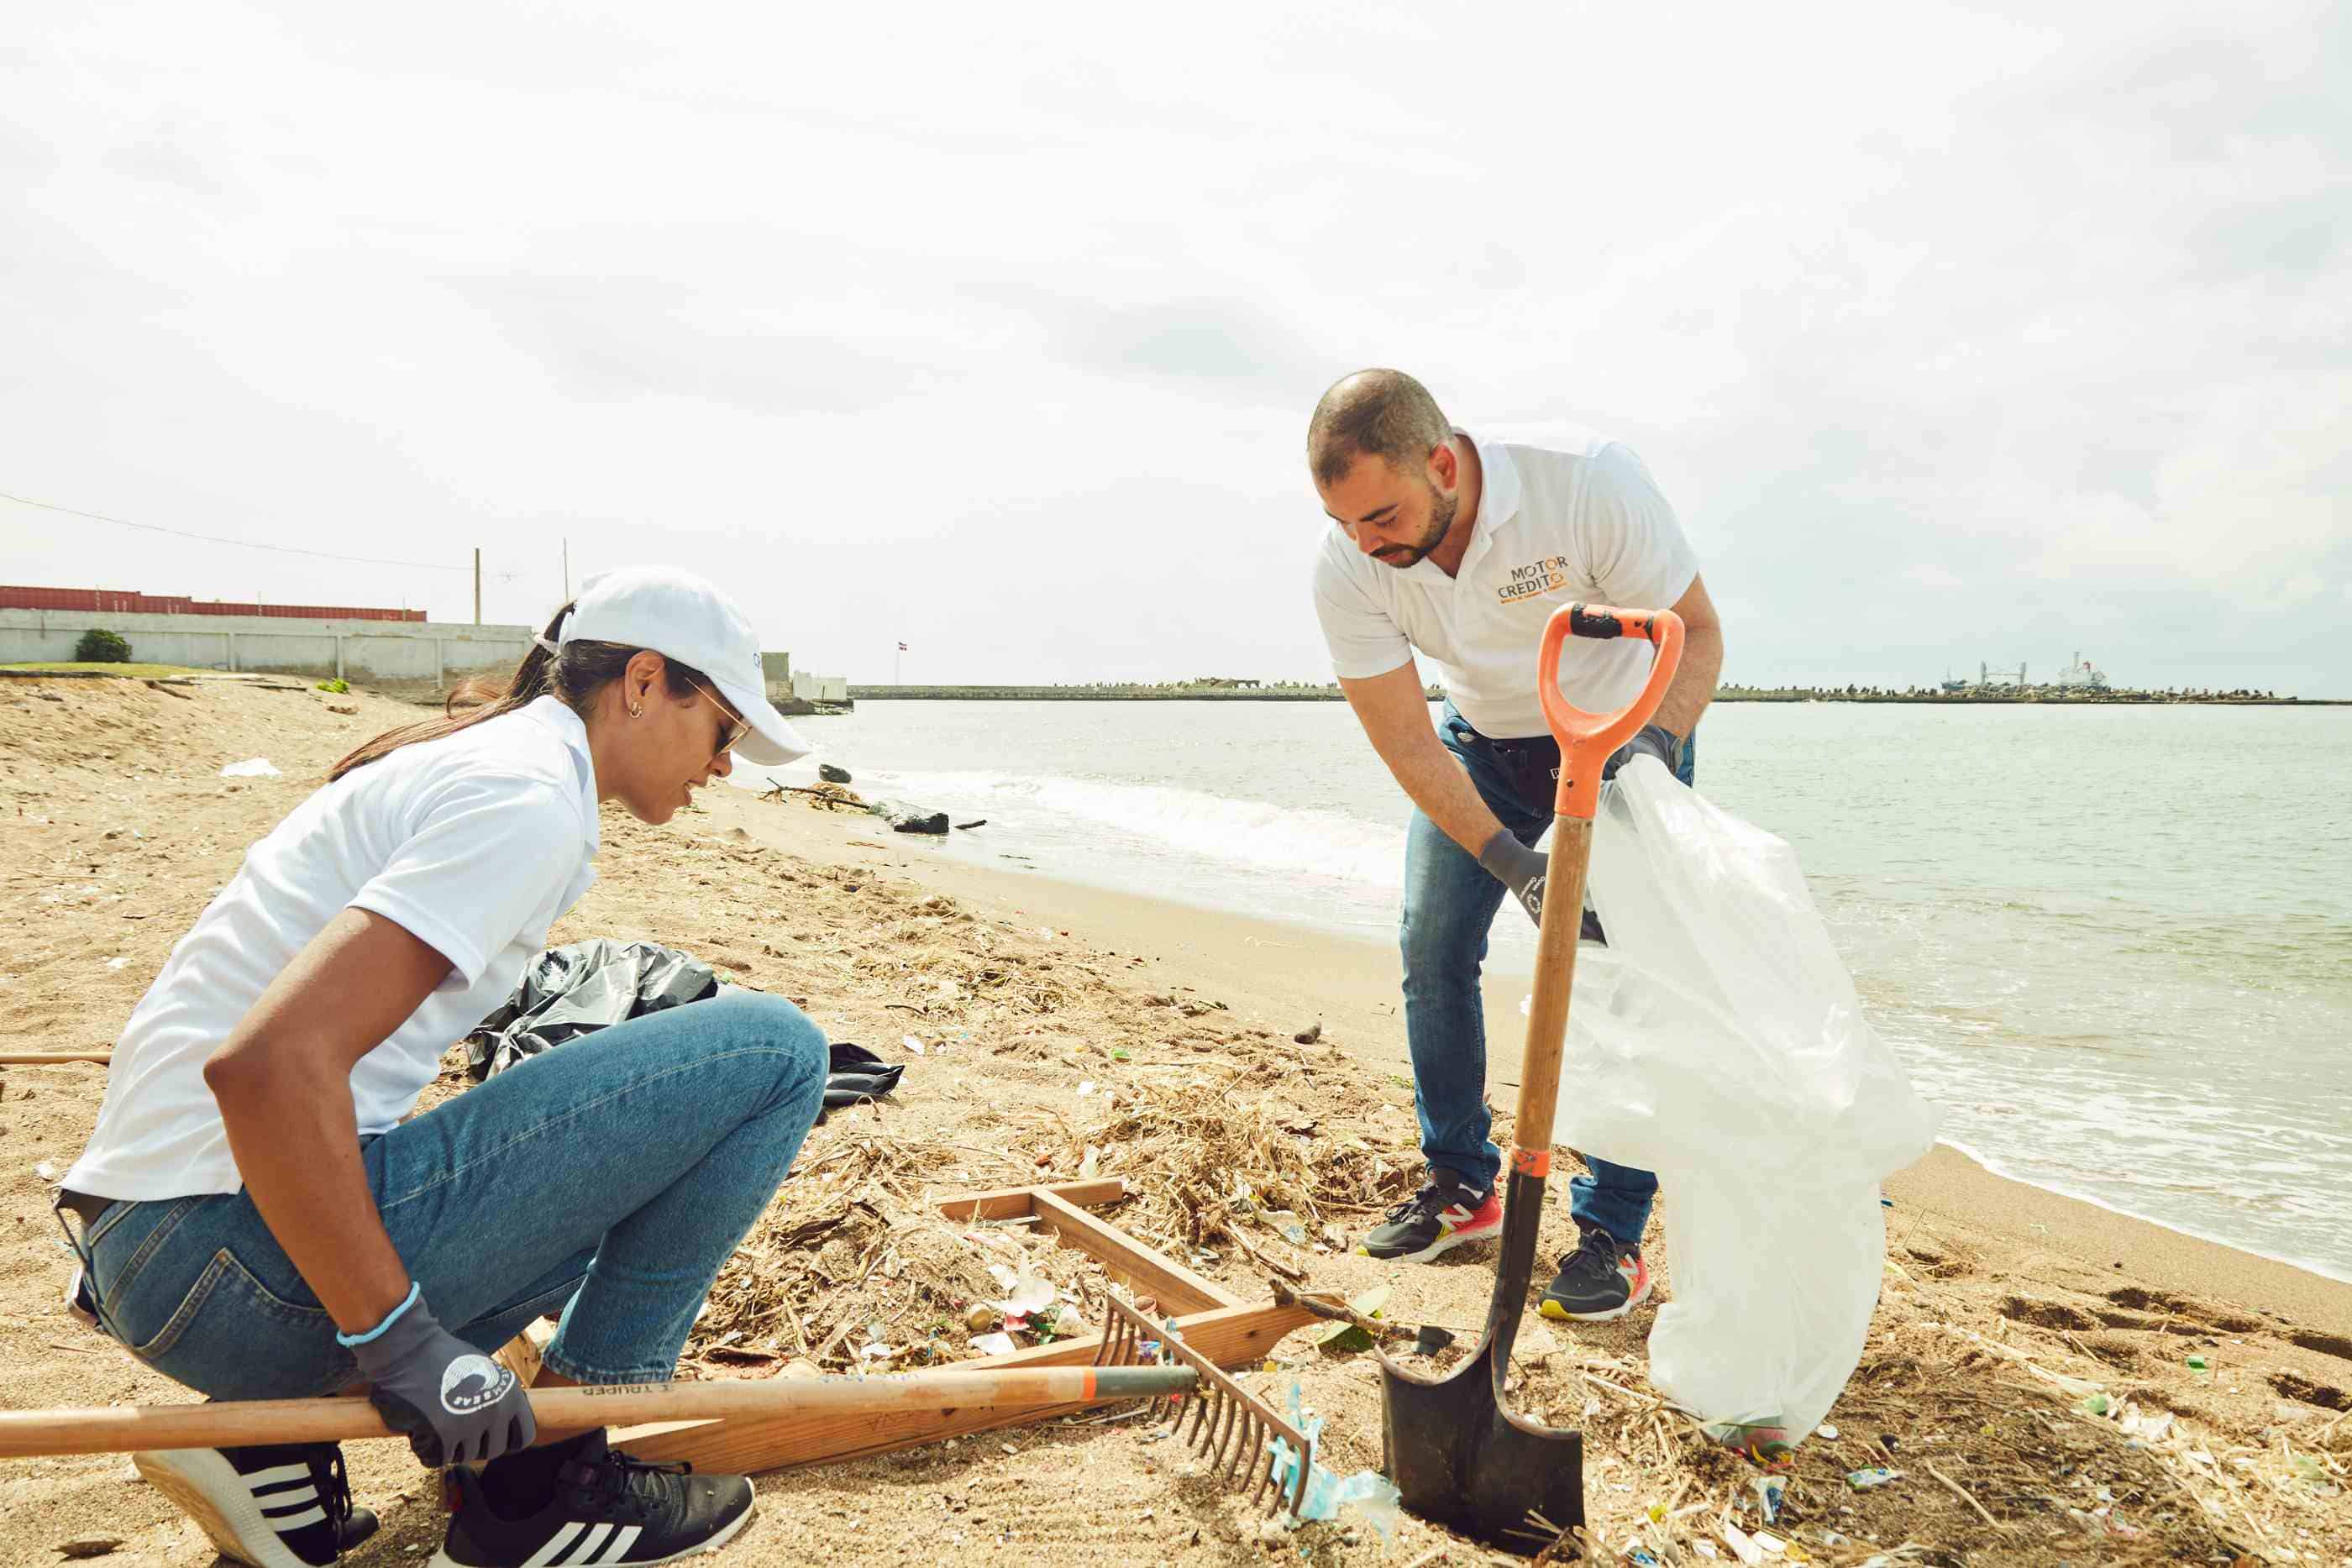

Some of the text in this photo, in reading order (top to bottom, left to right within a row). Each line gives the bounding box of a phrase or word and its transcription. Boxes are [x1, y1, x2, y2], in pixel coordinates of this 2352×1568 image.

[1511, 556, 1568, 581] MOTOR
[1499, 573, 1564, 598] CREDITO
[582, 1384, 653, 1396] TRUPER
